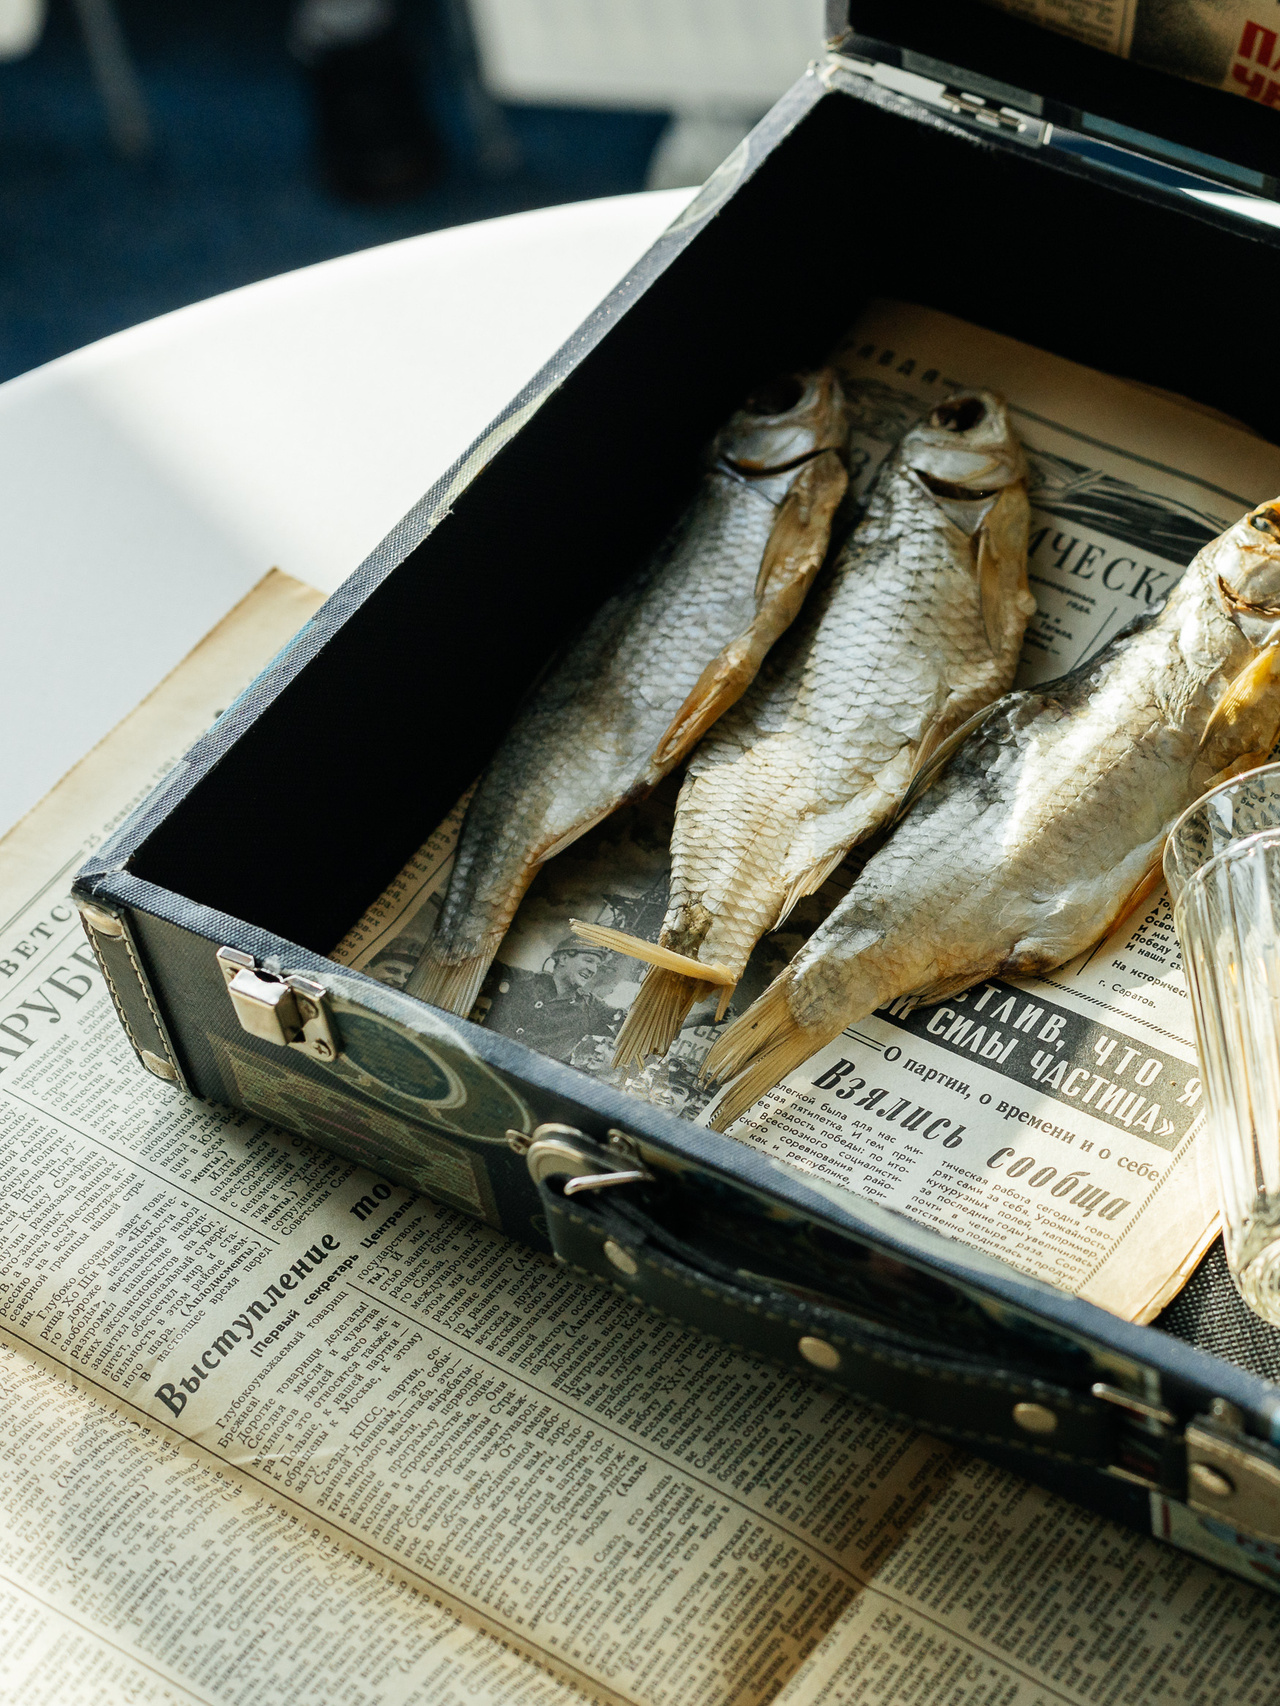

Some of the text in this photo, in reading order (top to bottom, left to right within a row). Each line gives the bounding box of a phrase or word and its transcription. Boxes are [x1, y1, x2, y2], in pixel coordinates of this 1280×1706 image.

[82, 833, 102, 849] 25
[1130, 932, 1172, 956] Победу
[1138, 924, 1170, 941] И мы
[1150, 908, 1160, 916] А
[1112, 960, 1126, 971] На
[1125, 942, 1136, 951] И
[1137, 947, 1166, 964] наши
[1098, 979, 1156, 1009] г. Саратов.
[765, 1092, 785, 1103] шая
[926, 1007, 1176, 1138] СИЛЫ ЧАСТИЦА»
[1094, 1035, 1163, 1090] ЧТО
[1177, 1077, 1202, 1107] Я
[771, 1080, 922, 1154] елегкой была для нас ми-
[773, 1108, 908, 1172] радость победы: по ито-
[810, 1058, 1130, 1220] Взялись сообща
[884, 1046, 1158, 1180] О партии, о времени и о себе
[739, 1116, 767, 1132] ского
[779, 1136, 852, 1171] соревнования
[863, 1174, 894, 1189] райо-
[749, 1133, 767, 1144] как
[785, 1151, 849, 1184] республике,
[862, 1185, 886, 1197] при-
[759, 1112, 901, 1181] Всесоюзного социалисти-
[941, 1160, 1113, 1240] тическая работа сегодня гово-
[154, 1233, 340, 1418] Выступление
[350, 1184, 393, 1222] то
[250, 1309, 300, 1358] (Первый
[303, 1254, 359, 1306] секретарь
[215, 1291, 348, 1428] Глубокоуважаемый товарищ
[236, 1301, 368, 1444] Дорогие товарищи делегаты!
[242, 1404, 286, 1448] Сегодня
[293, 1362, 324, 1394] мысли
[343, 1308, 379, 1341] чувства
[304, 1337, 366, 1401] людей всего
[333, 1373, 364, 1404] нашей
[217, 1396, 262, 1449] Брежнев!
[338, 1377, 381, 1413] Москве,
[349, 1368, 424, 1439] КПСС, партии,
